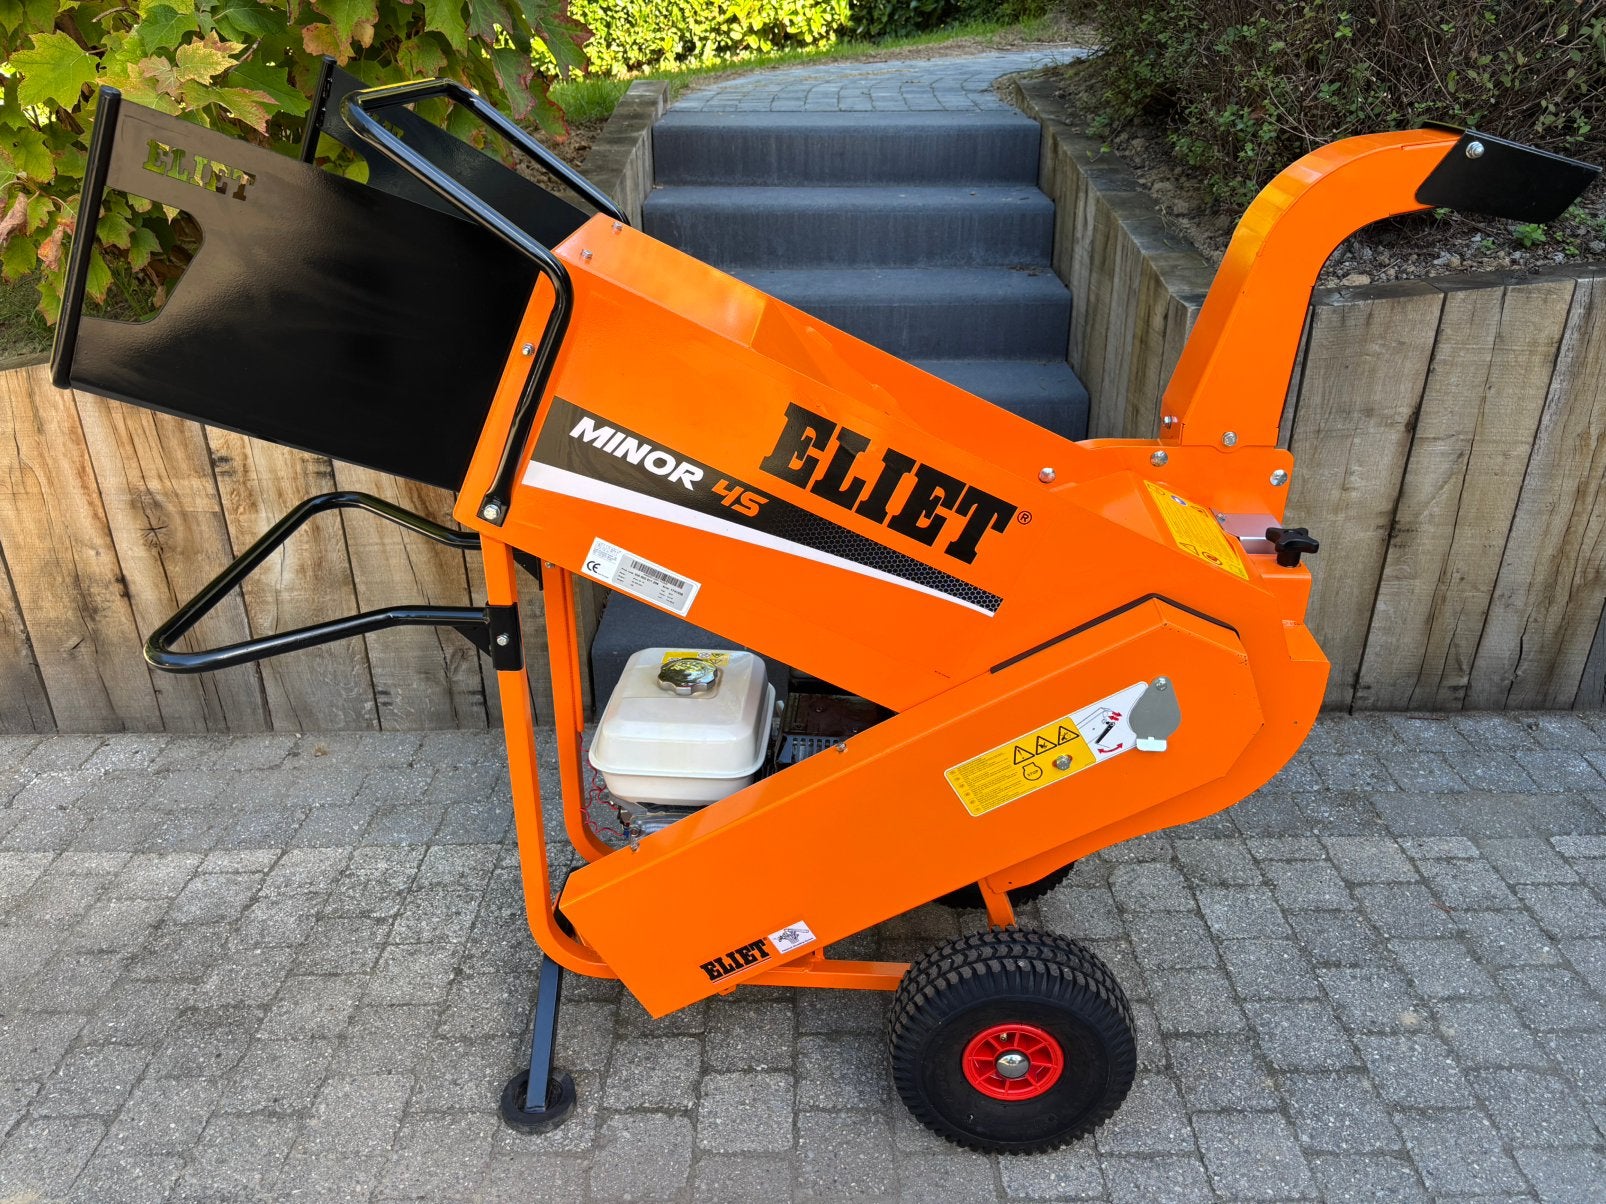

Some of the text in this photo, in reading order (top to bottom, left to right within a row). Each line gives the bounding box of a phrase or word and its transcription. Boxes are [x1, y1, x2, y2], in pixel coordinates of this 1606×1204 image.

[142, 139, 257, 202] ELIET
[568, 416, 704, 491] MINOR
[699, 938, 770, 982] ELIET
